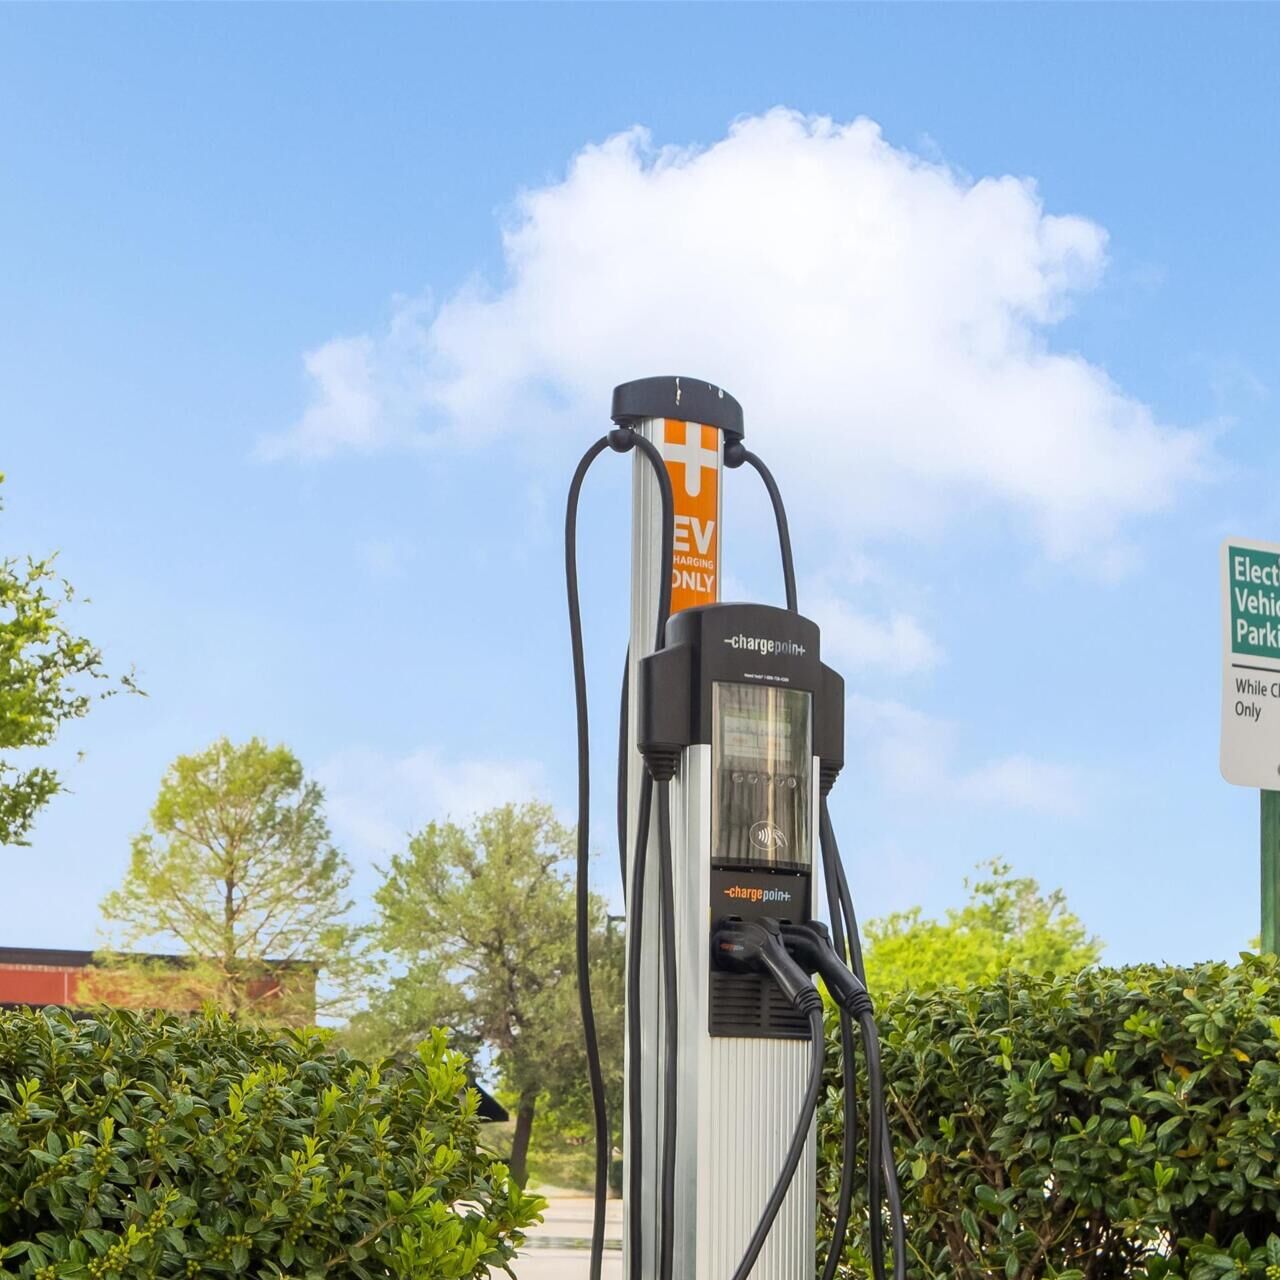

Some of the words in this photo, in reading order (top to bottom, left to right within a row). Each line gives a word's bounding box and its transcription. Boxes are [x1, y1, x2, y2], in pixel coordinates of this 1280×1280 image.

[672, 514, 715, 555] EV
[672, 555, 714, 569] HARGING
[1235, 678, 1268, 697] While
[1235, 700, 1262, 722] Only
